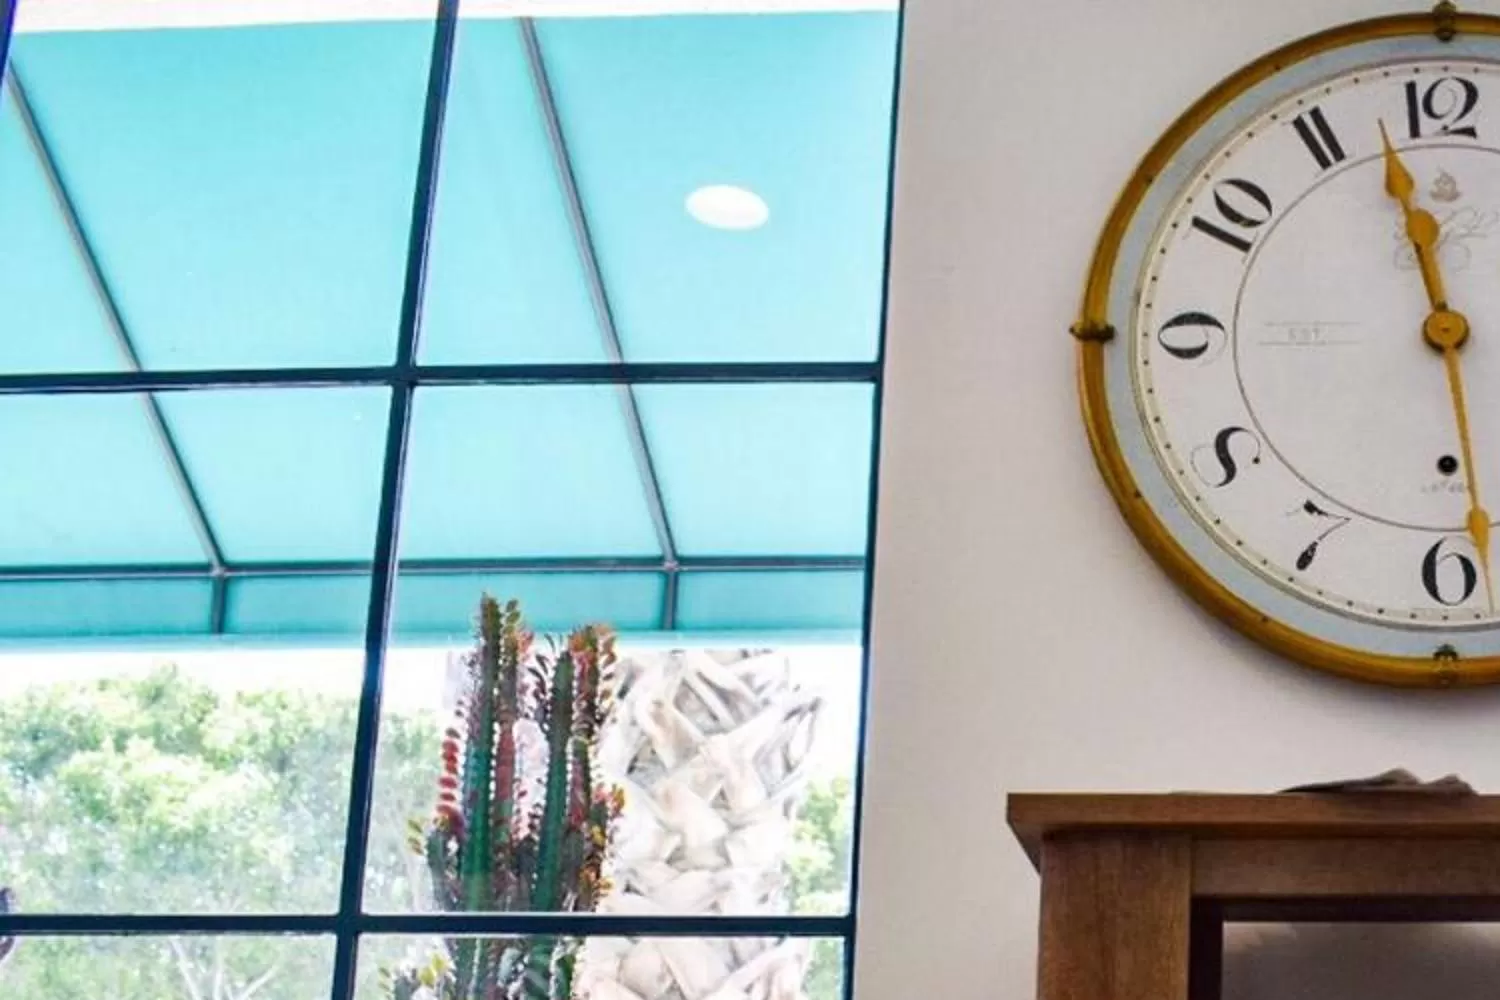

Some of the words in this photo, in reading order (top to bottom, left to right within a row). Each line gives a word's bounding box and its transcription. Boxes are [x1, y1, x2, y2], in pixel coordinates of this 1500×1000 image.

[1405, 76, 1482, 140] 12
[1191, 177, 1273, 254] 10
[1157, 309, 1226, 362] 9
[1188, 424, 1263, 488] 8
[1281, 498, 1351, 572] 7
[1420, 536, 1479, 607] 6
